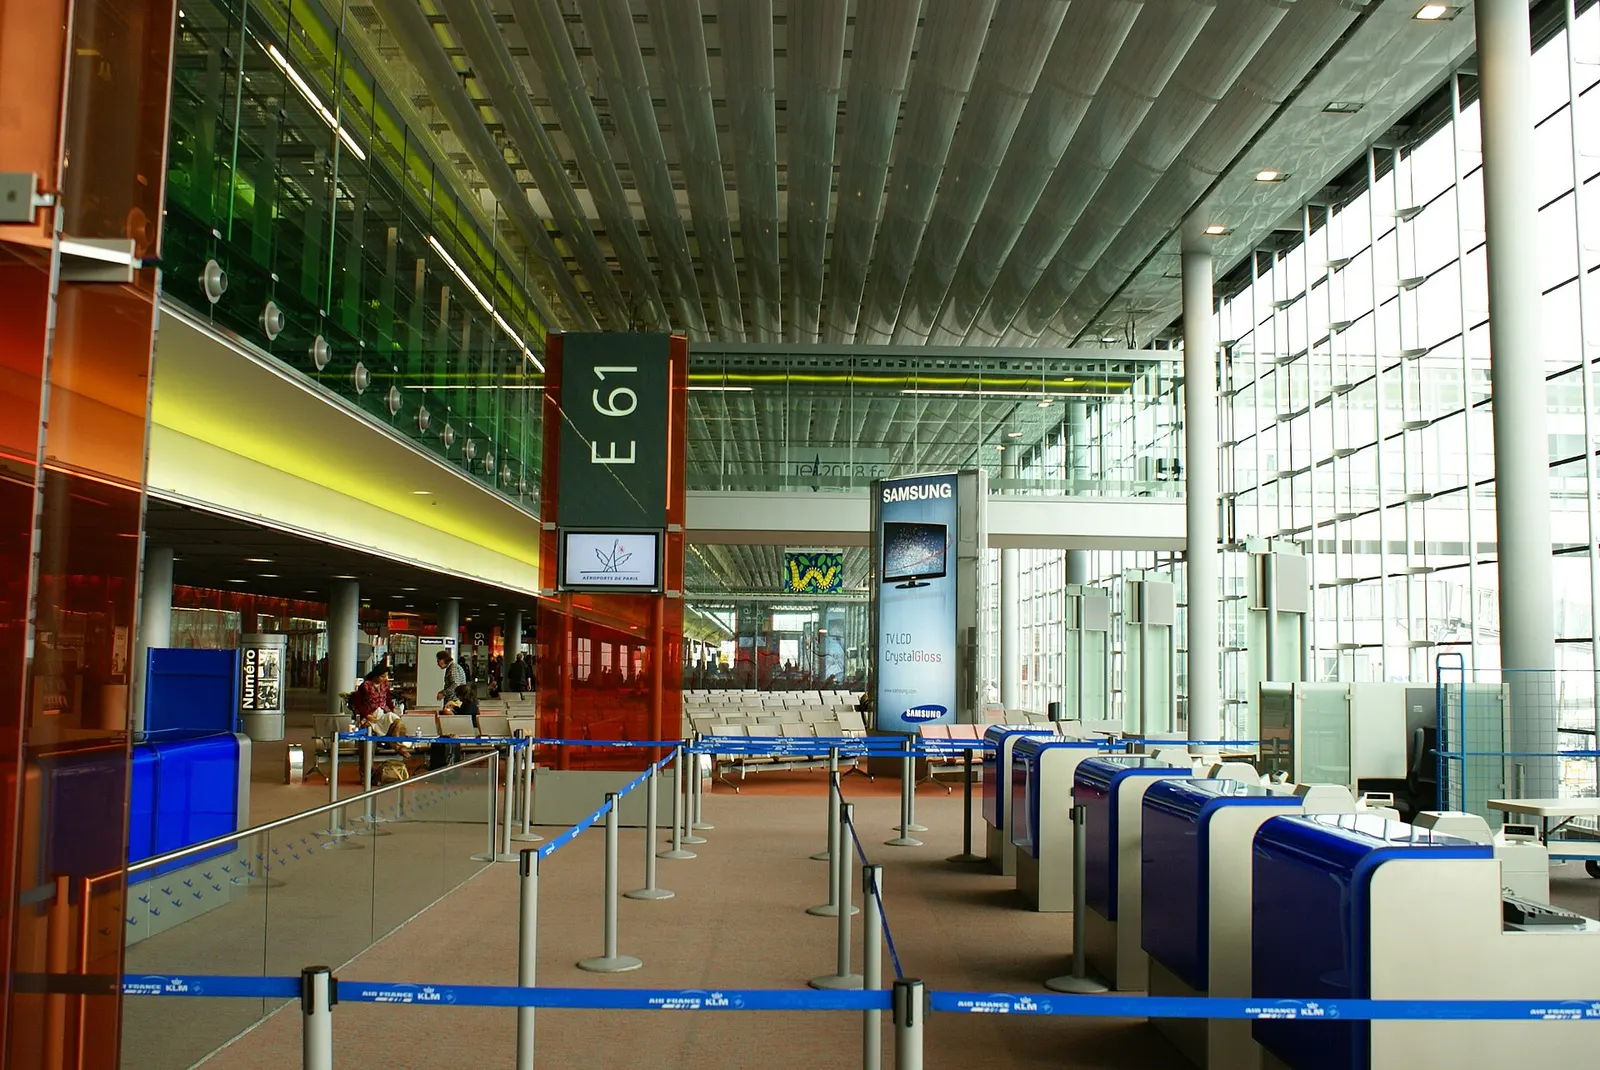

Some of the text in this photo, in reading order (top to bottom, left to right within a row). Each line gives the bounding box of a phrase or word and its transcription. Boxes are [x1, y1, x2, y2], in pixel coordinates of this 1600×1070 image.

[591, 366, 638, 464] E 61
[882, 483, 952, 503] SAMSUNG
[474, 632, 485, 647] 59
[886, 633, 911, 645] TV LCD
[885, 650, 942, 665] CrystalGloss
[242, 649, 256, 709] Numéro
[906, 709, 942, 719] SAMSUNG
[165, 984, 188, 992] KLM
[417, 992, 441, 1001] KLM
[705, 998, 729, 1007] KLM
[1013, 1002, 1037, 1011] KLM
[1300, 1008, 1325, 1017] KLM
